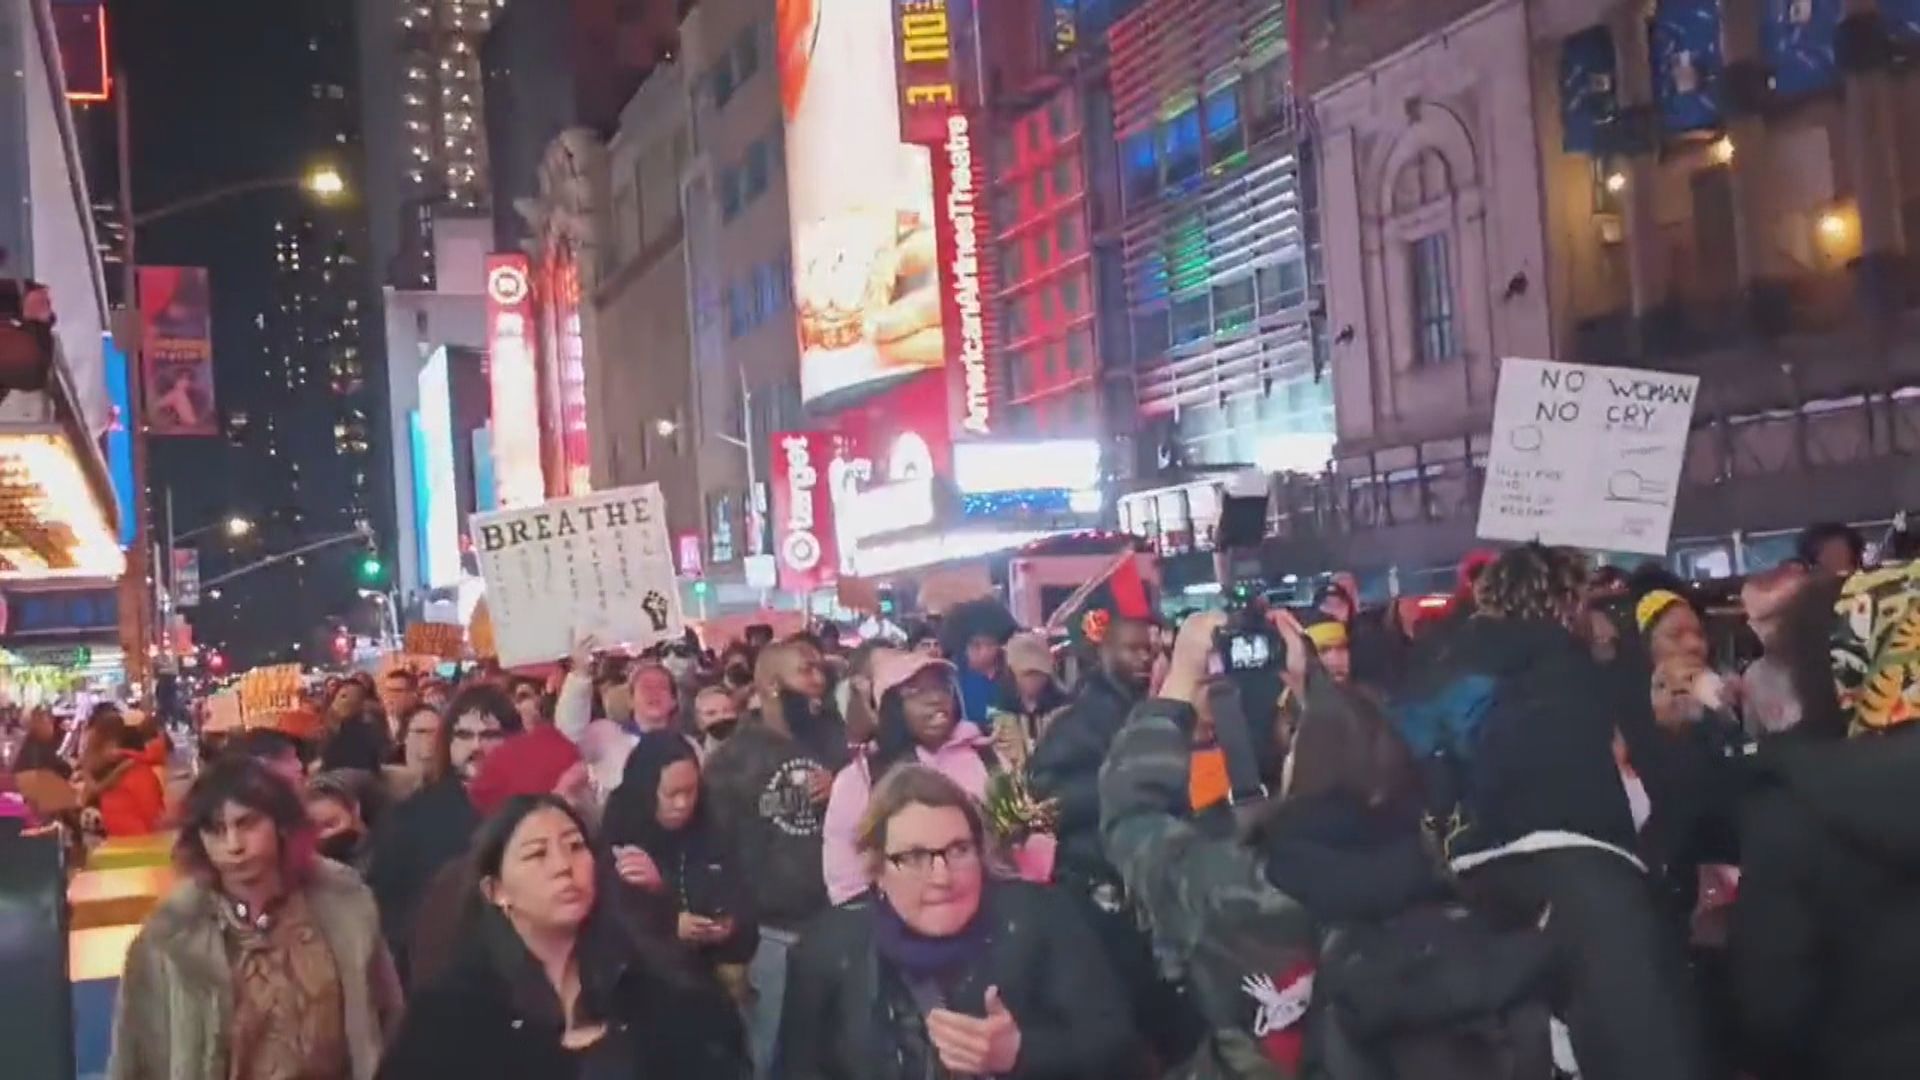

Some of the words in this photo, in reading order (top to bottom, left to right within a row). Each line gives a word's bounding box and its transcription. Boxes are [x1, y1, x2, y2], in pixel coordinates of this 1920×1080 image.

[1540, 368, 1585, 393] NO
[1608, 378, 1693, 404] WOMAN
[1535, 402, 1580, 422] NO
[1606, 403, 1657, 427] CRY
[479, 498, 651, 551] BREATHE
